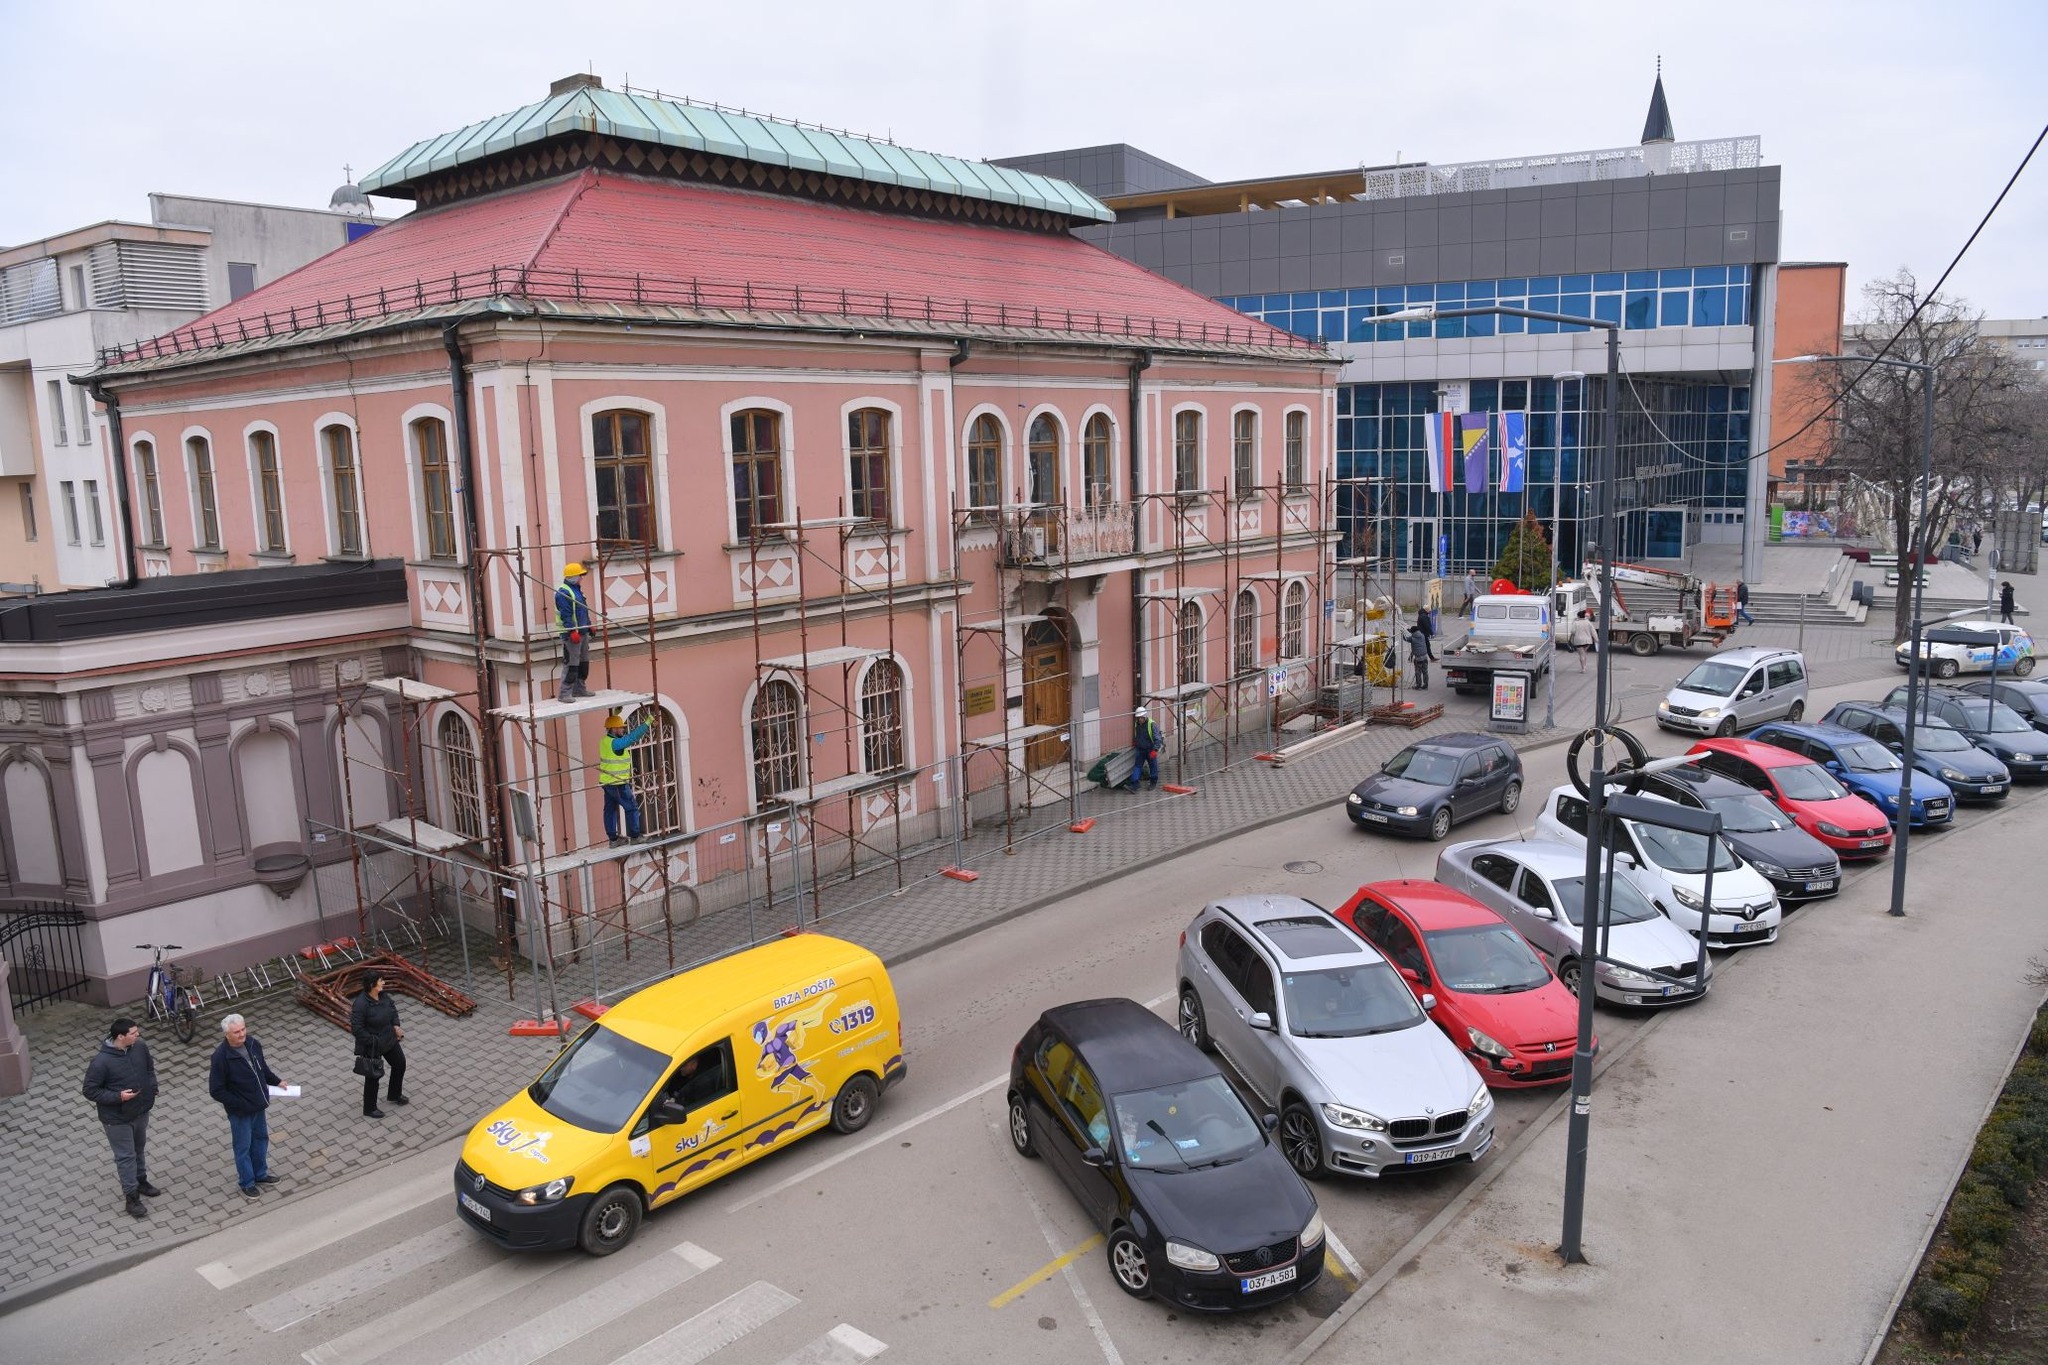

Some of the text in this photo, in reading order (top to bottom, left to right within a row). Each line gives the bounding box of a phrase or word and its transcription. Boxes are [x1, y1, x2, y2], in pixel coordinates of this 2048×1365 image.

[773, 978, 836, 1010] BRZA POŠTA
[840, 1005, 875, 1032] 1319
[486, 1120, 521, 1146] sky
[675, 1134, 699, 1153] sky
[1413, 1150, 1455, 1163] 019-A-777
[1248, 1268, 1296, 1291] 037-A-581
